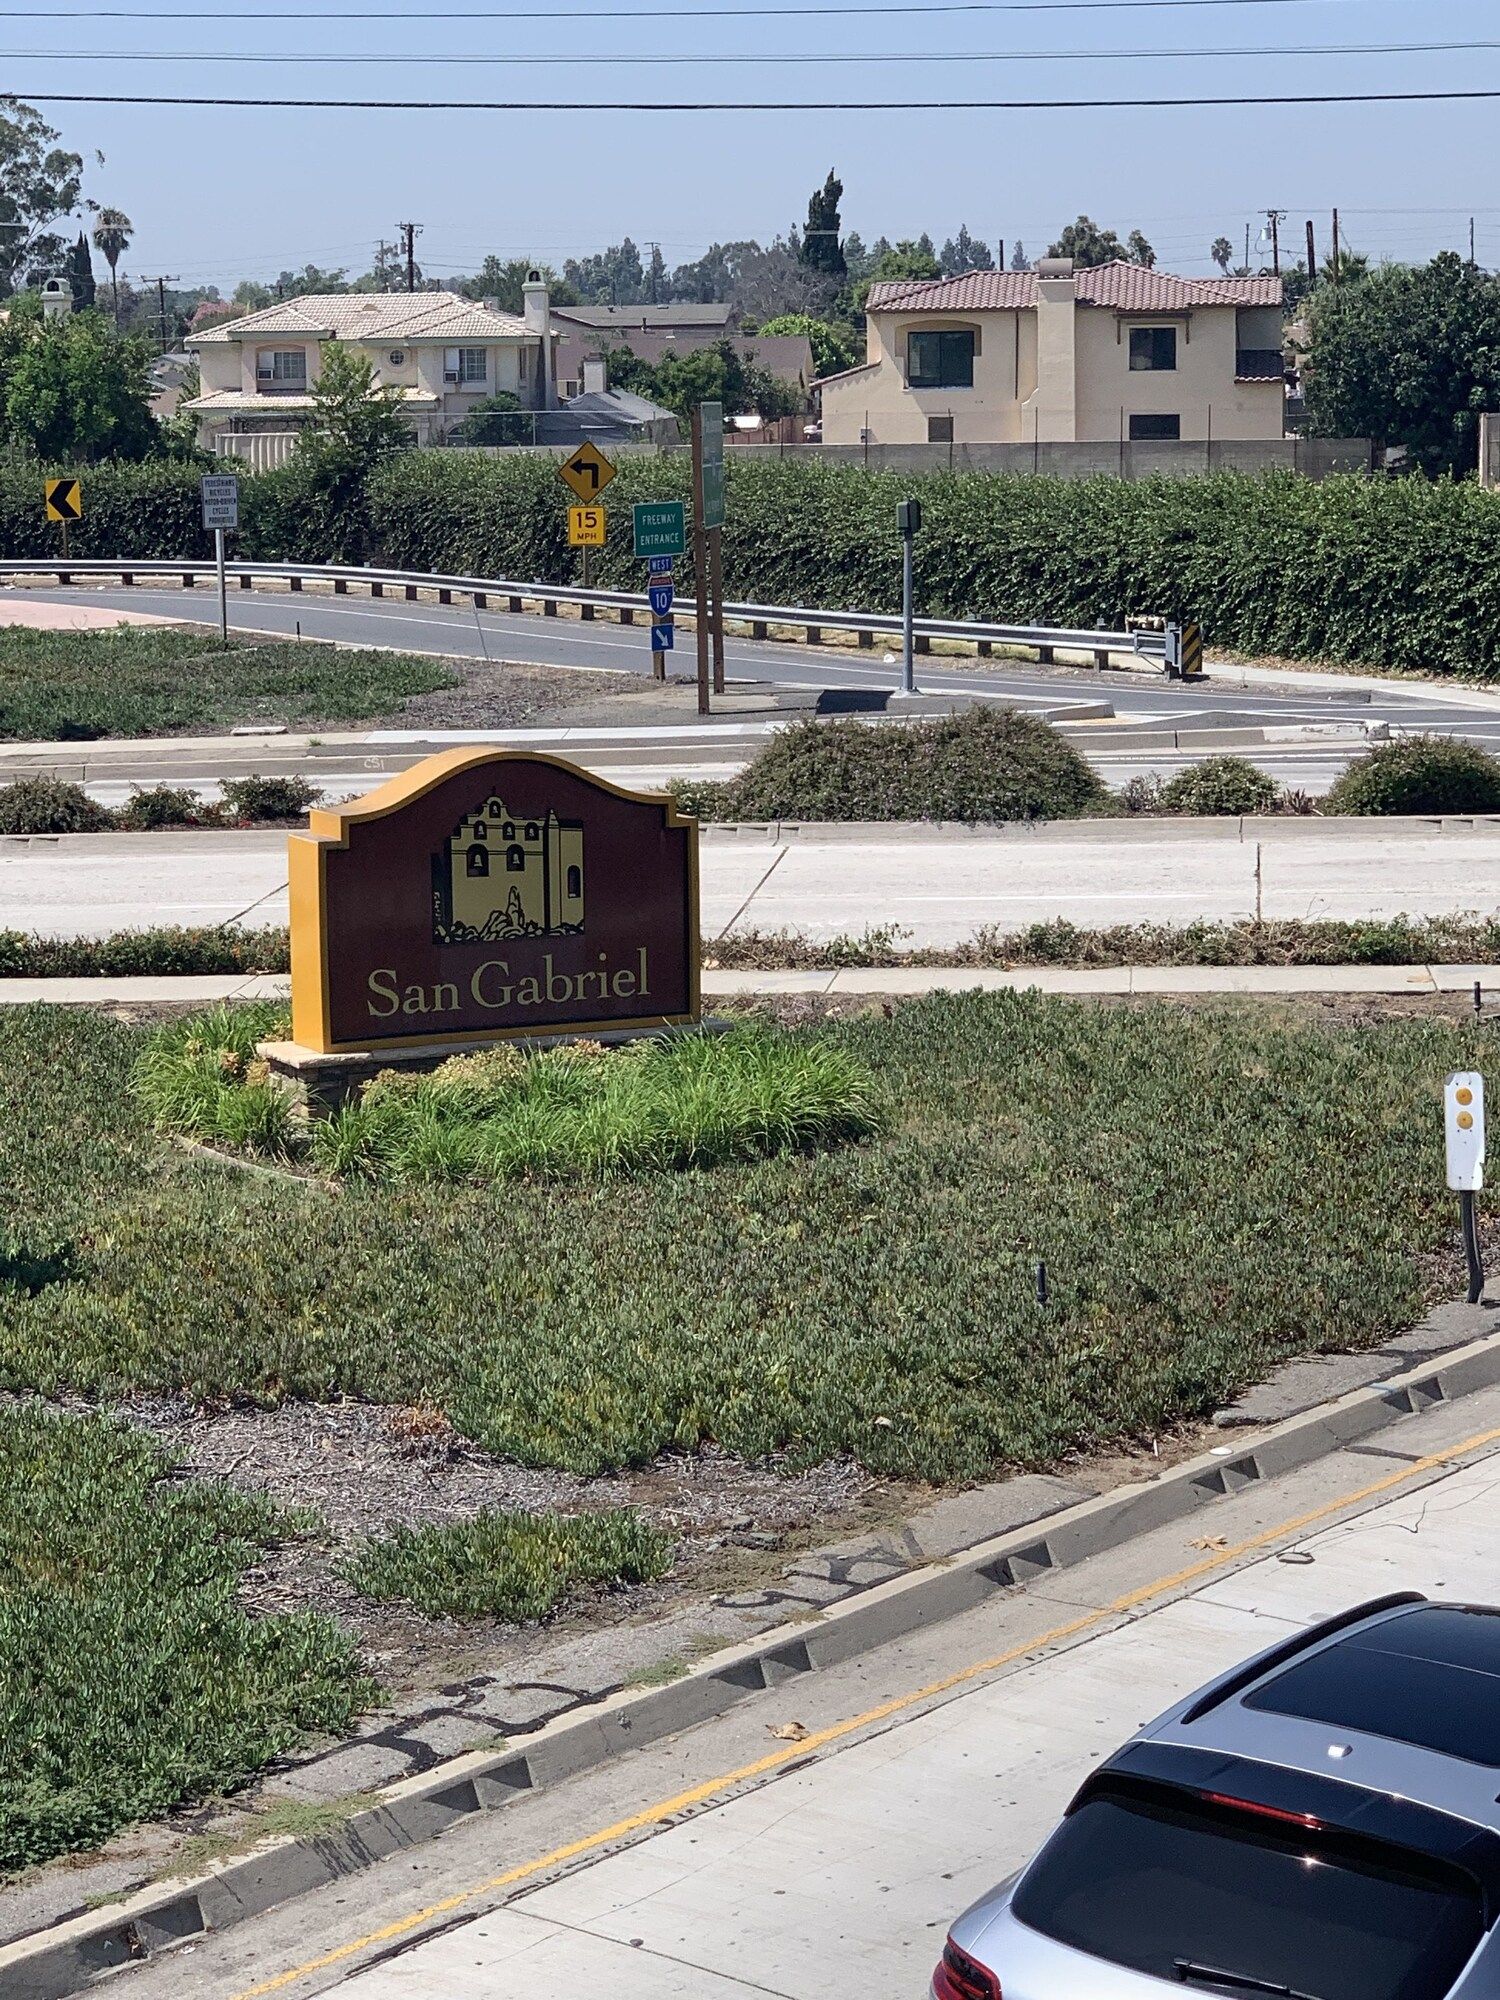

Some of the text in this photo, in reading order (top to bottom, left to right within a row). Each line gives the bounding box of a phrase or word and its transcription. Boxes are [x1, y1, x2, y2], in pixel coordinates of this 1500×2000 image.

[576, 511, 597, 529] 15
[642, 513, 676, 526] FREEWAY
[577, 532, 597, 541] MPH
[640, 532, 679, 546] ENTRANCE
[651, 558, 670, 571] WEST
[655, 592, 668, 609] 10
[367, 947, 651, 1018] San Gabriel
